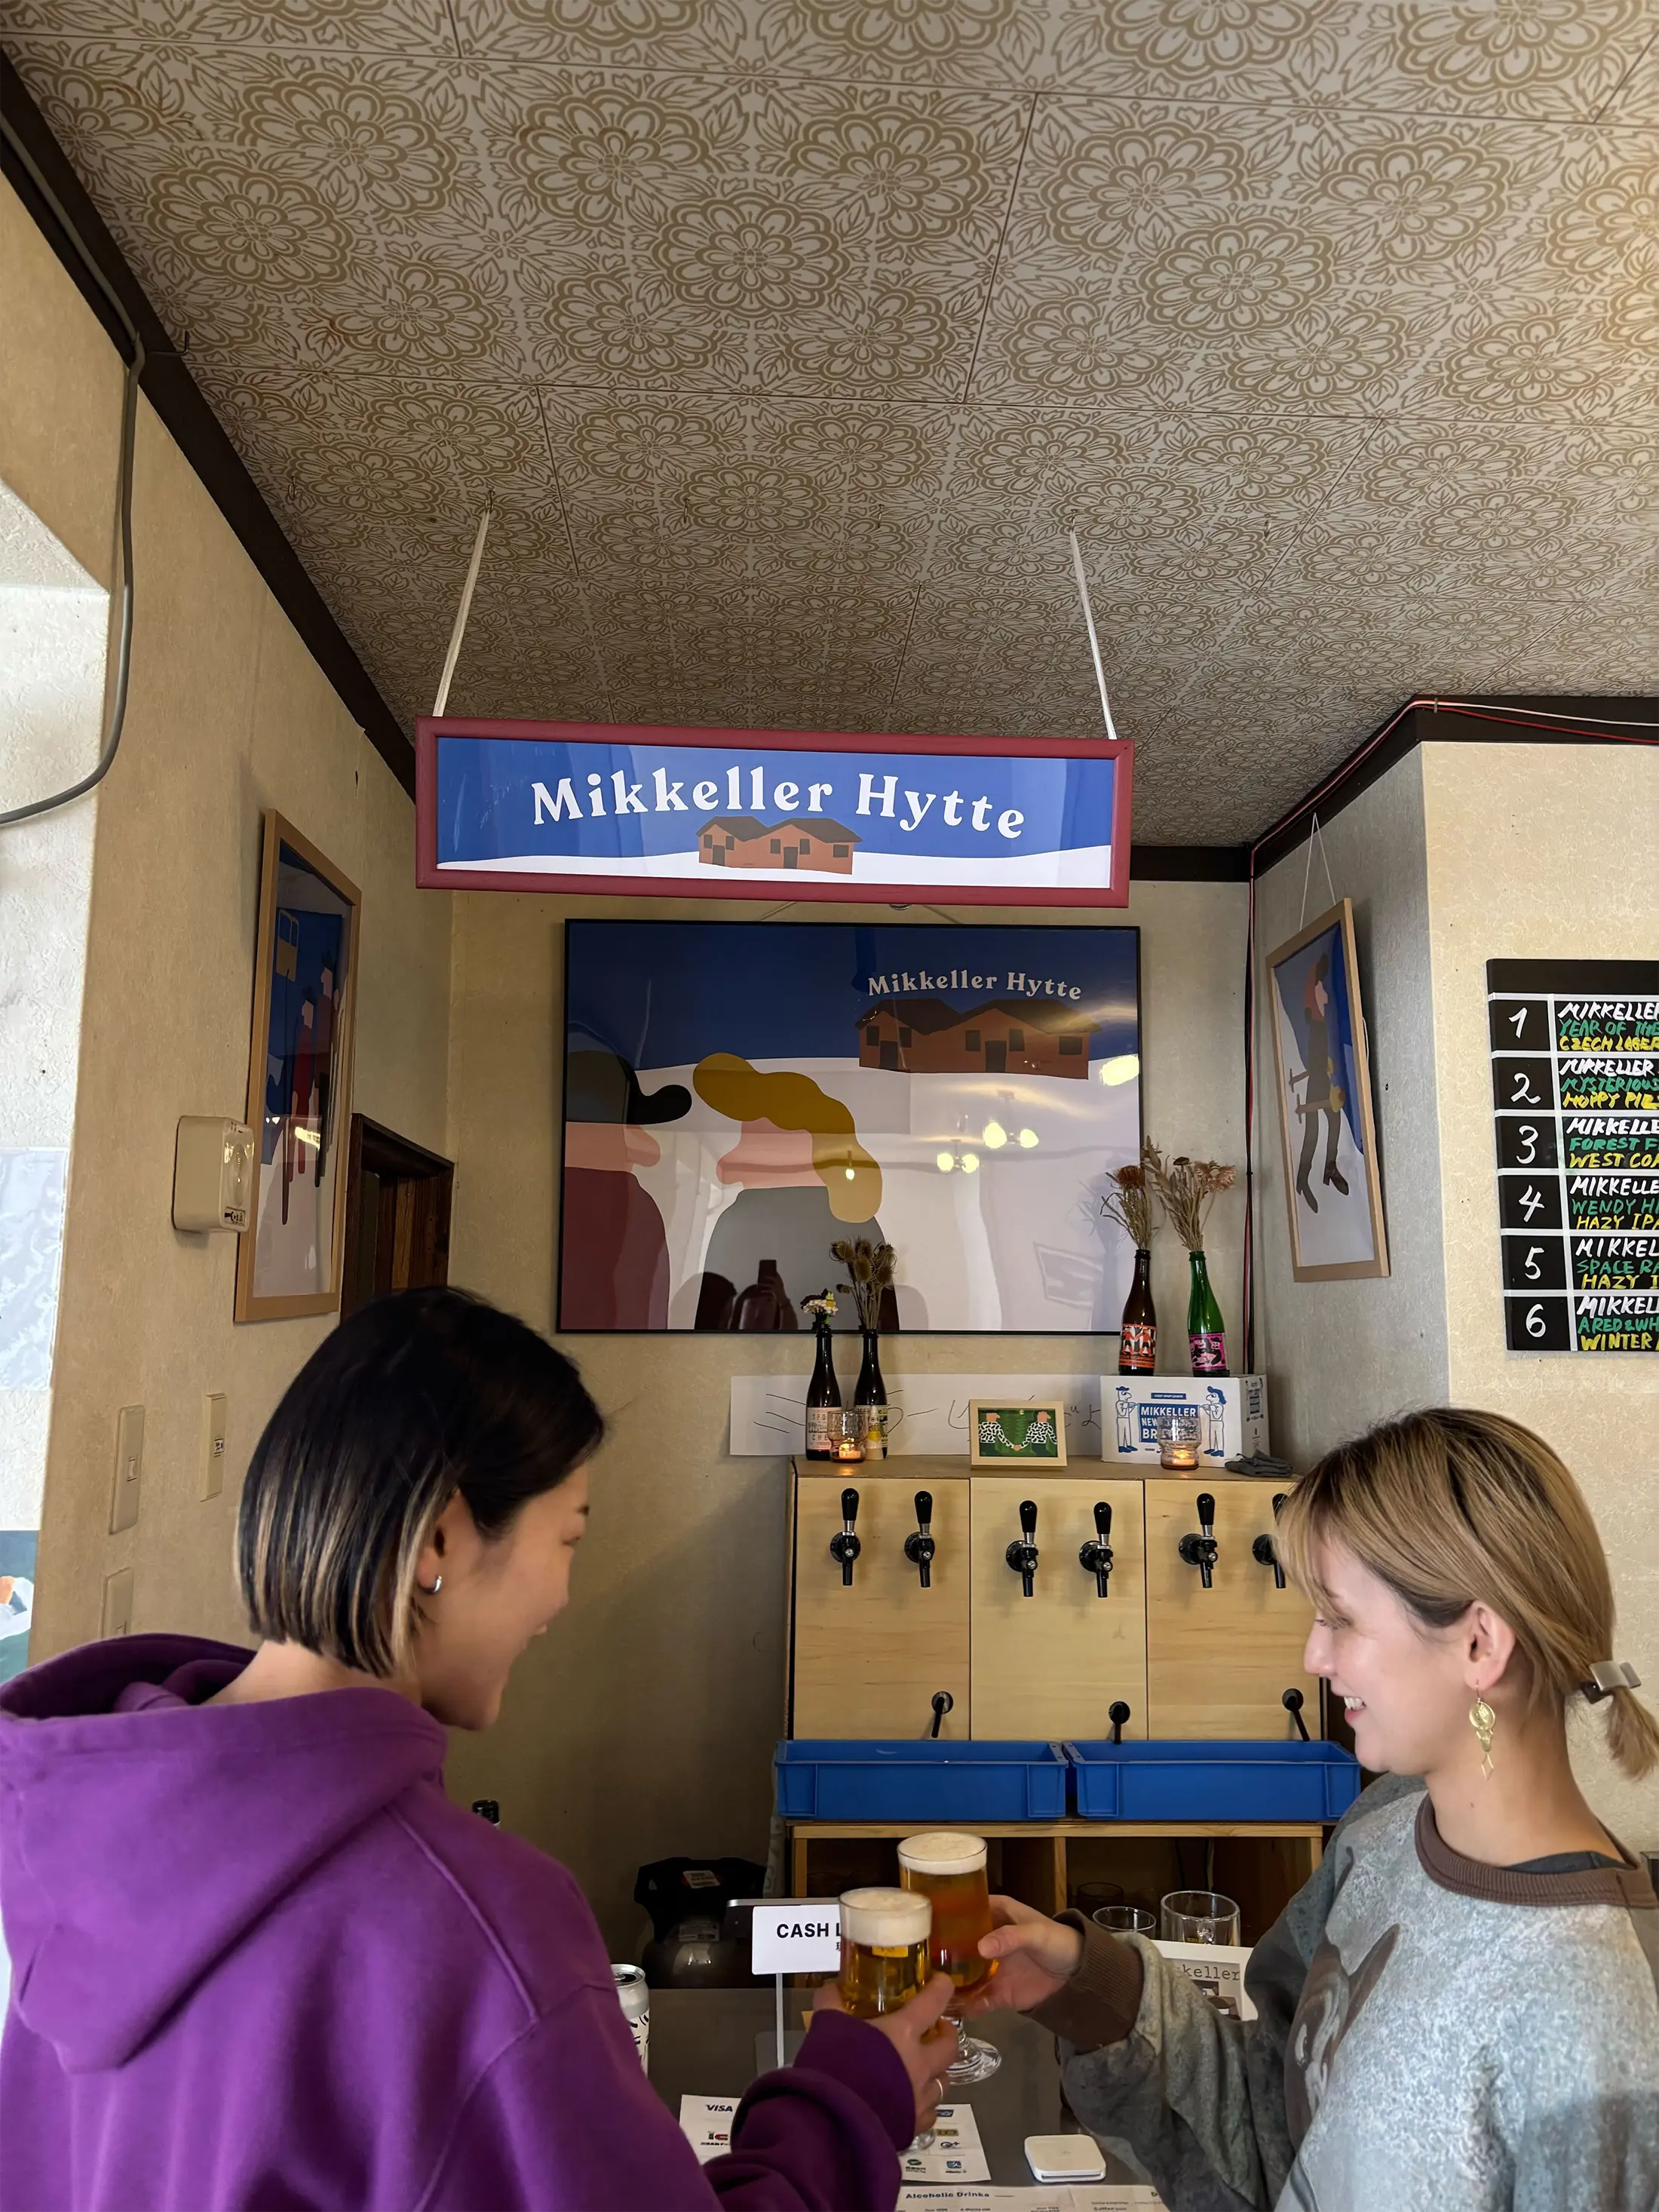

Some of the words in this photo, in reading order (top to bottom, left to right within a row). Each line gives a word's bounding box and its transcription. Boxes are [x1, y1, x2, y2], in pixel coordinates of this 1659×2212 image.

[531, 765, 833, 824] Mikkeller
[854, 773, 1025, 839] Hytte
[868, 970, 998, 996] Mikkeller
[1007, 971, 1081, 1000] Hytte
[1508, 1008, 1529, 1039] 1
[1559, 1018, 1603, 1037] YEAR
[1605, 1020, 1627, 1036] OF
[1559, 1035, 1613, 1051] CZECH
[1559, 1058, 1655, 1077] MIKKELLER
[1510, 1072, 1542, 1105] 2
[1562, 1091, 1620, 1109] HOPPY
[1625, 1091, 1659, 1109] PIL
[1516, 1125, 1539, 1164] 3
[1569, 1137, 1640, 1151] FOREST
[1569, 1152, 1624, 1168] WEST
[1518, 1185, 1545, 1223] 4
[1572, 1198, 1636, 1215] WENDY
[1576, 1214, 1624, 1229] HAZY
[1524, 1247, 1544, 1280] 5
[1576, 1259, 1635, 1275] SPACE
[1581, 1274, 1639, 1290] HAZY
[1525, 1303, 1546, 1337] 6
[1581, 1333, 1652, 1351] WINTER
[1141, 1407, 1196, 1416] MIKKELLER
[776, 1922, 829, 1938] CASH
[1177, 1964, 1240, 1981] keller
